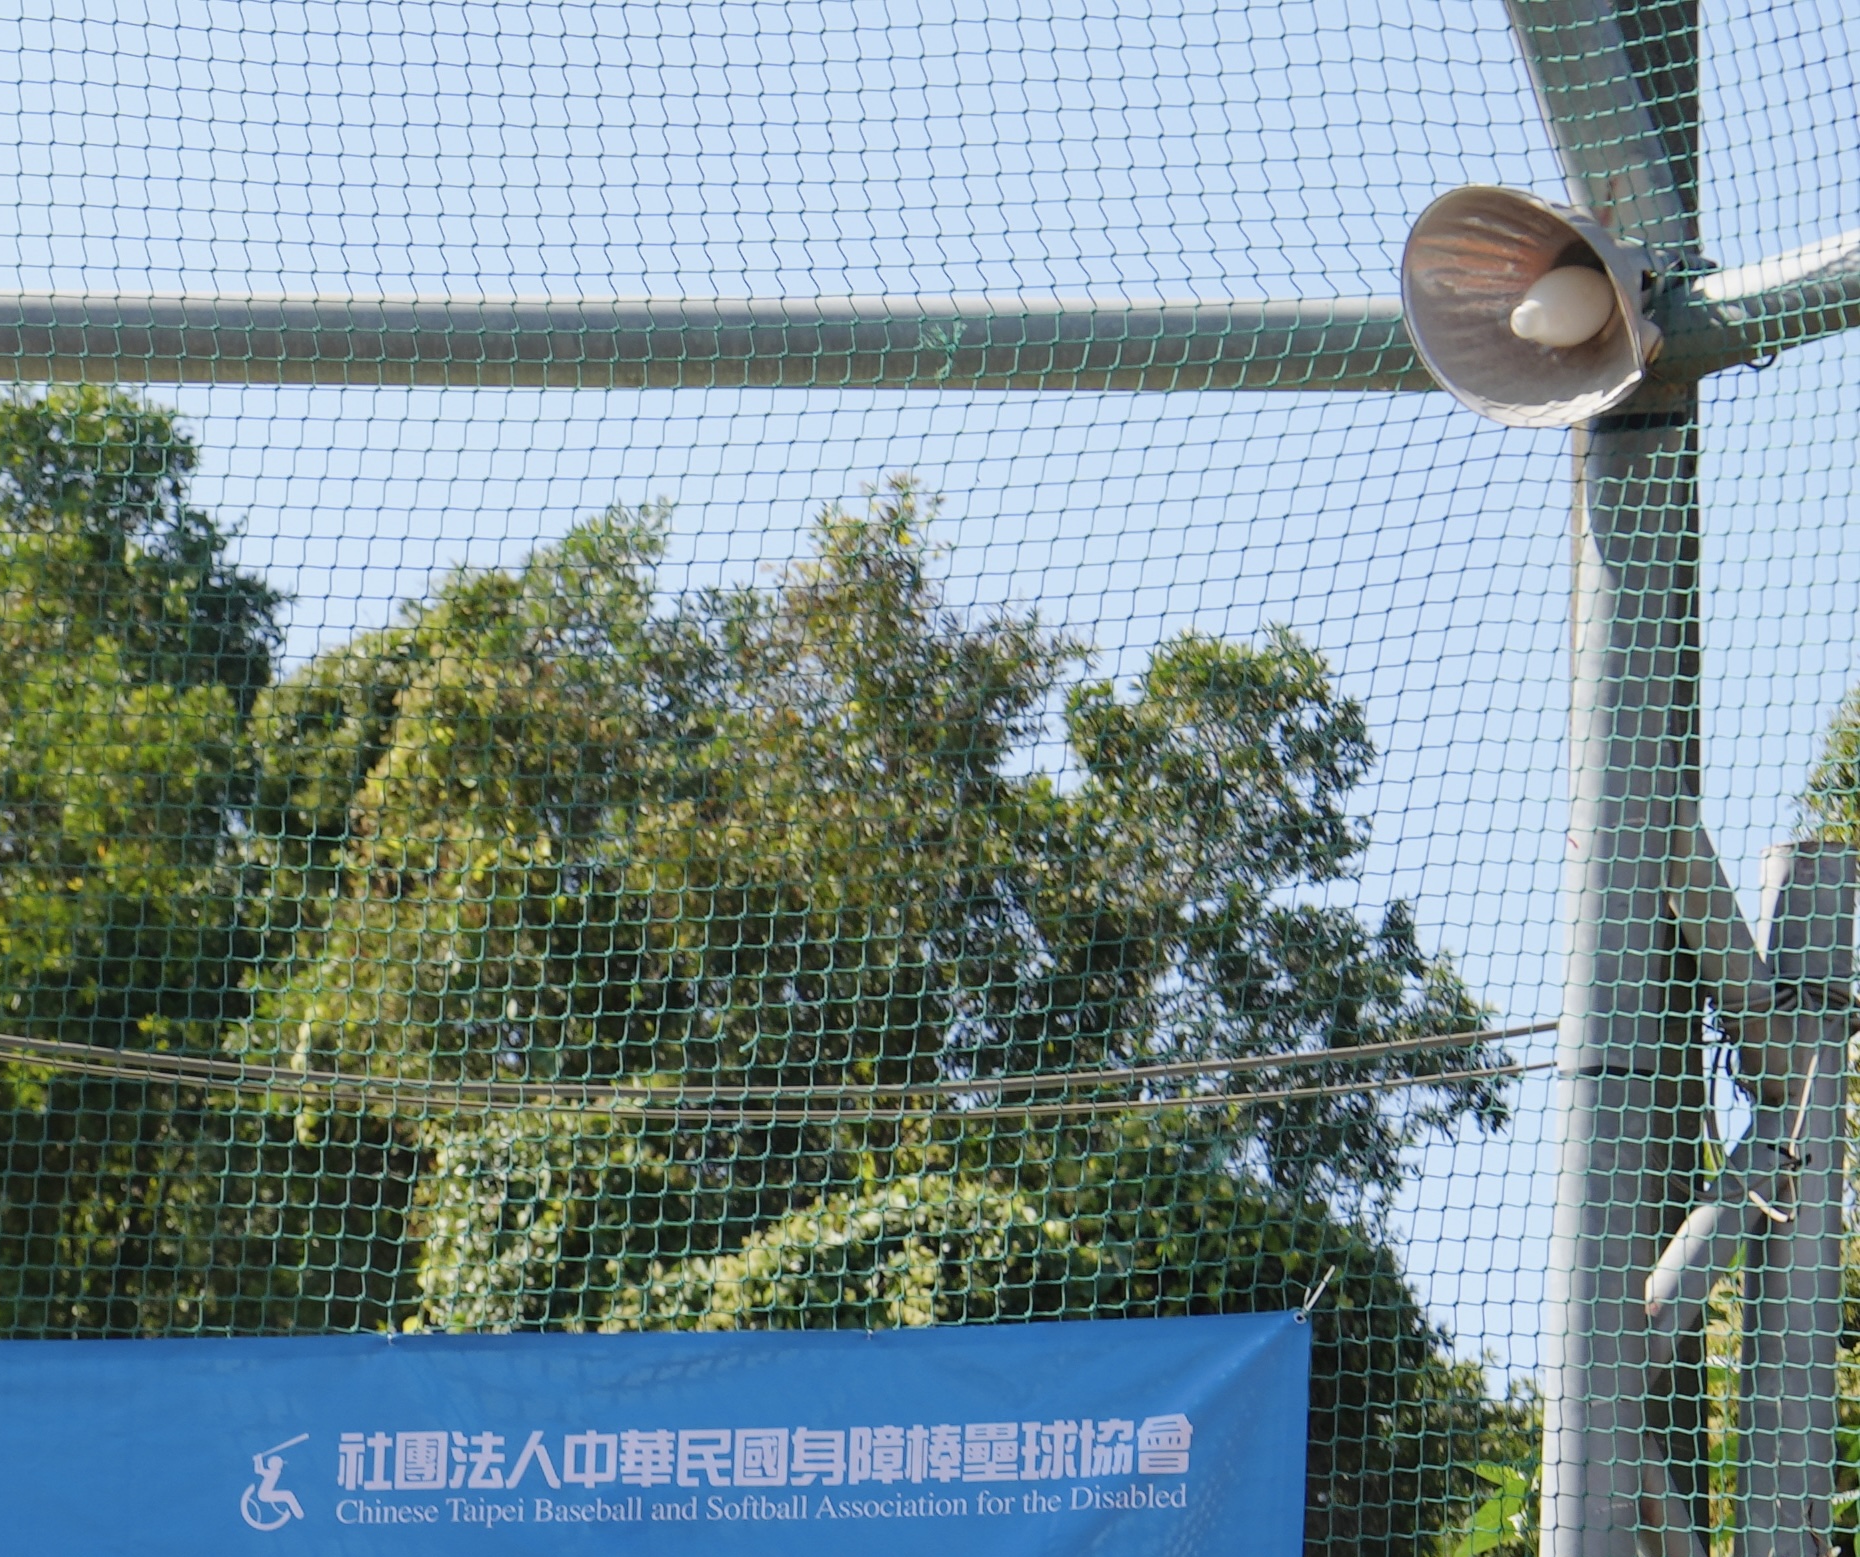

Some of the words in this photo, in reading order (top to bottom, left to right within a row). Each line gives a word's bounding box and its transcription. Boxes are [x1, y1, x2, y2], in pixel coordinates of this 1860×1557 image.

[337, 1413, 1194, 1491] 社團法人中華民國身障棒壘球協會
[336, 1499, 439, 1525] Chinese
[446, 1498, 525, 1528] Taipei
[534, 1496, 643, 1522] Baseball
[651, 1497, 698, 1521] and
[706, 1494, 808, 1521] Softball
[815, 1492, 970, 1519] Association
[976, 1489, 1017, 1515] for
[1023, 1487, 1063, 1513] the
[1070, 1483, 1187, 1511] Disabled
